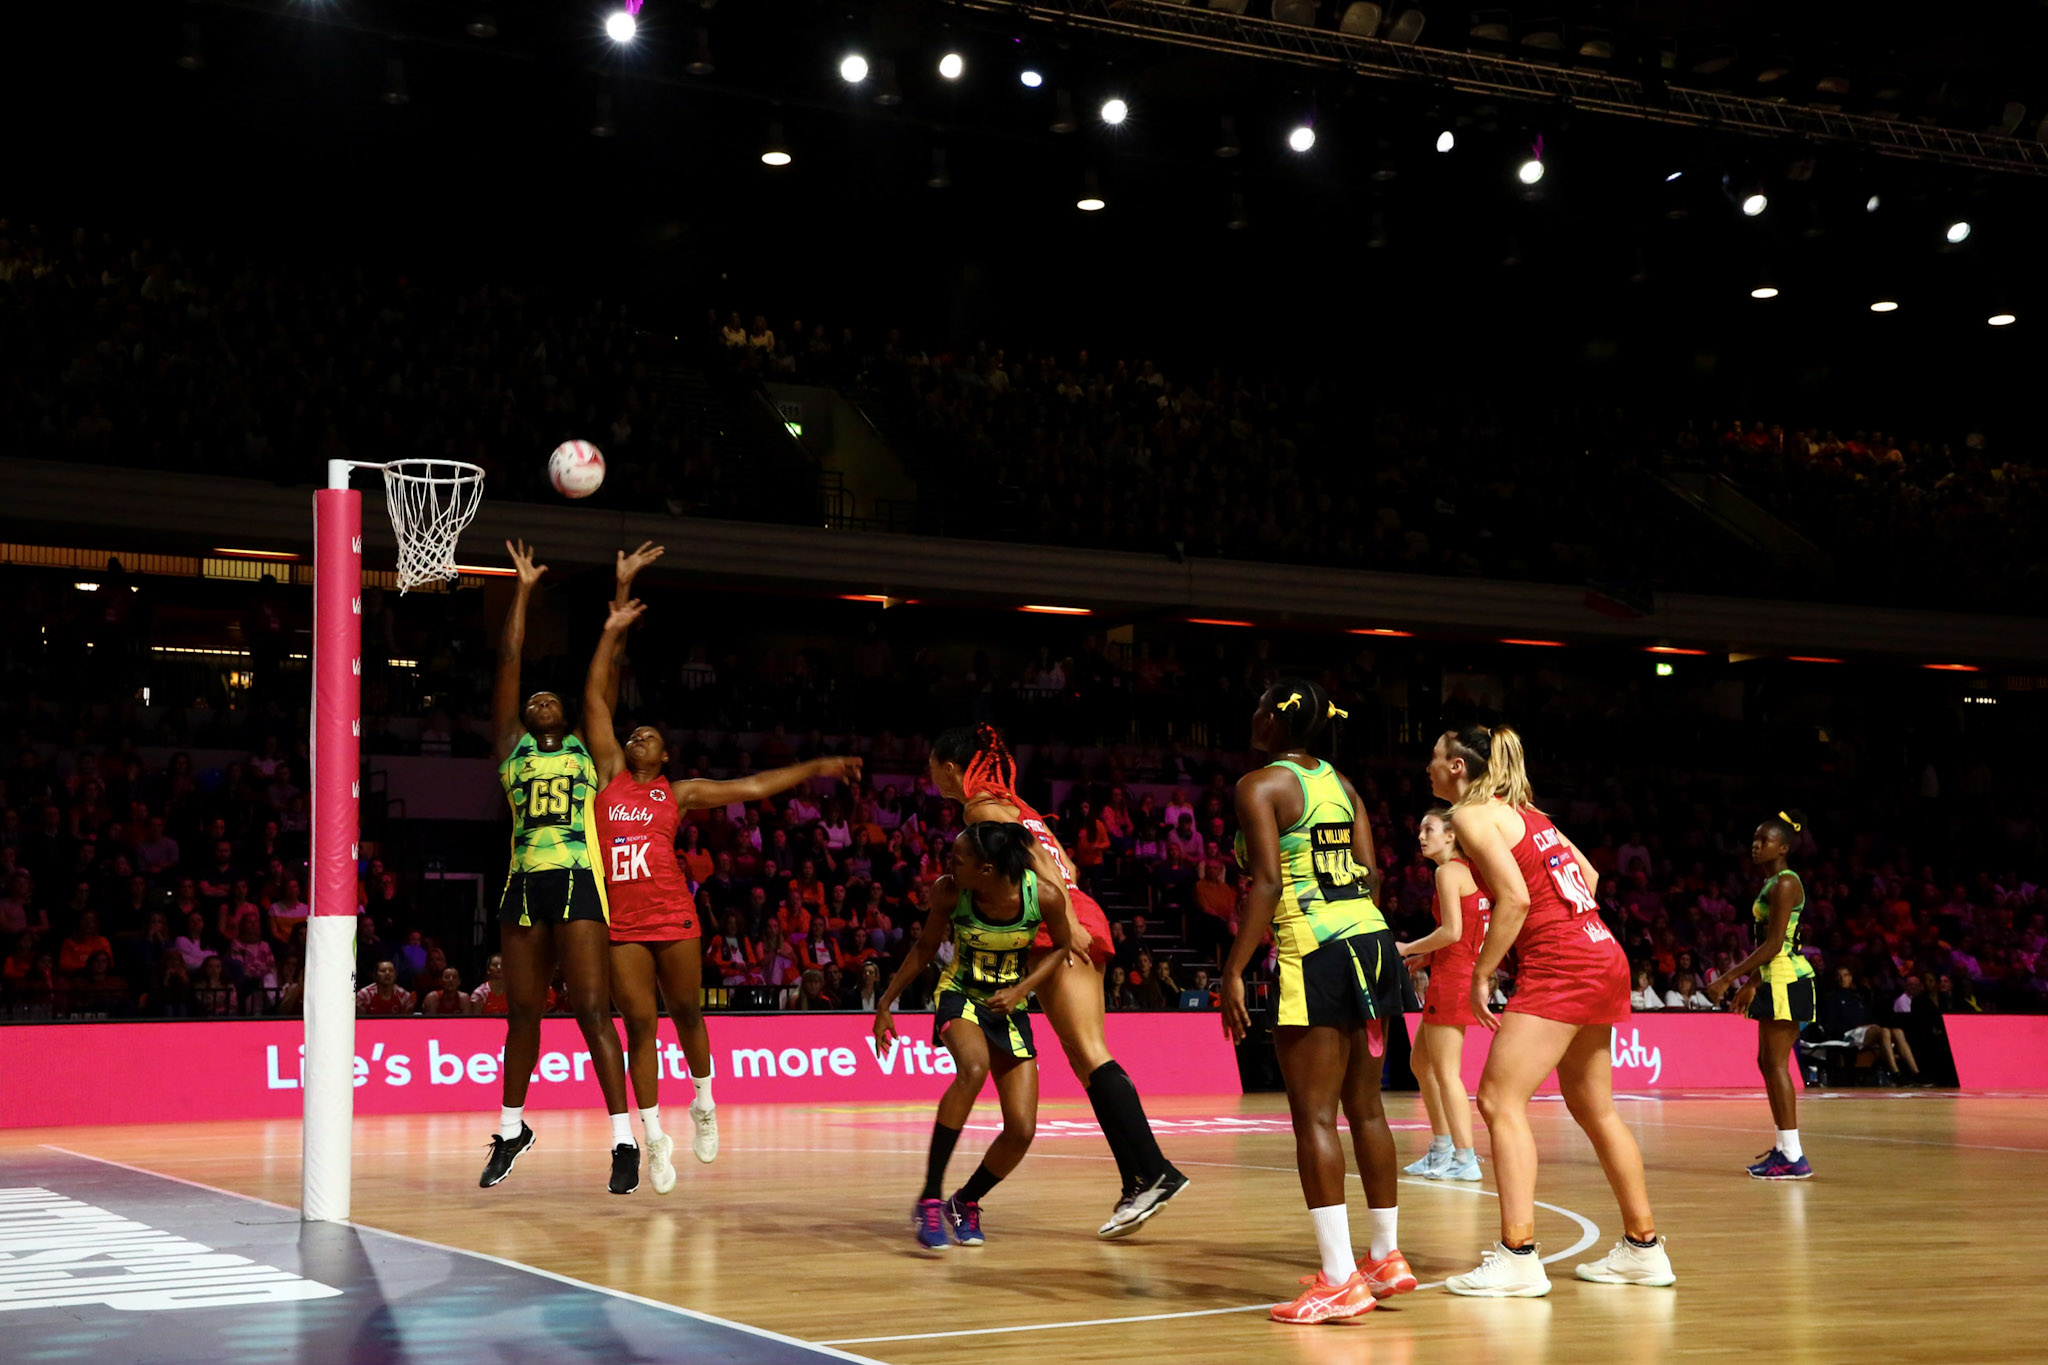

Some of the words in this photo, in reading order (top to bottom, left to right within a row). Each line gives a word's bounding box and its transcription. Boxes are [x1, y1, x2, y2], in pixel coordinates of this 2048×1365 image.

[529, 777, 570, 817] GS
[608, 803, 653, 827] Vitality
[611, 842, 652, 882] GK
[266, 1042, 412, 1090] Lie's
[428, 1039, 592, 1085] beer
[731, 1047, 857, 1078] more
[1610, 1026, 1662, 1084] lity
